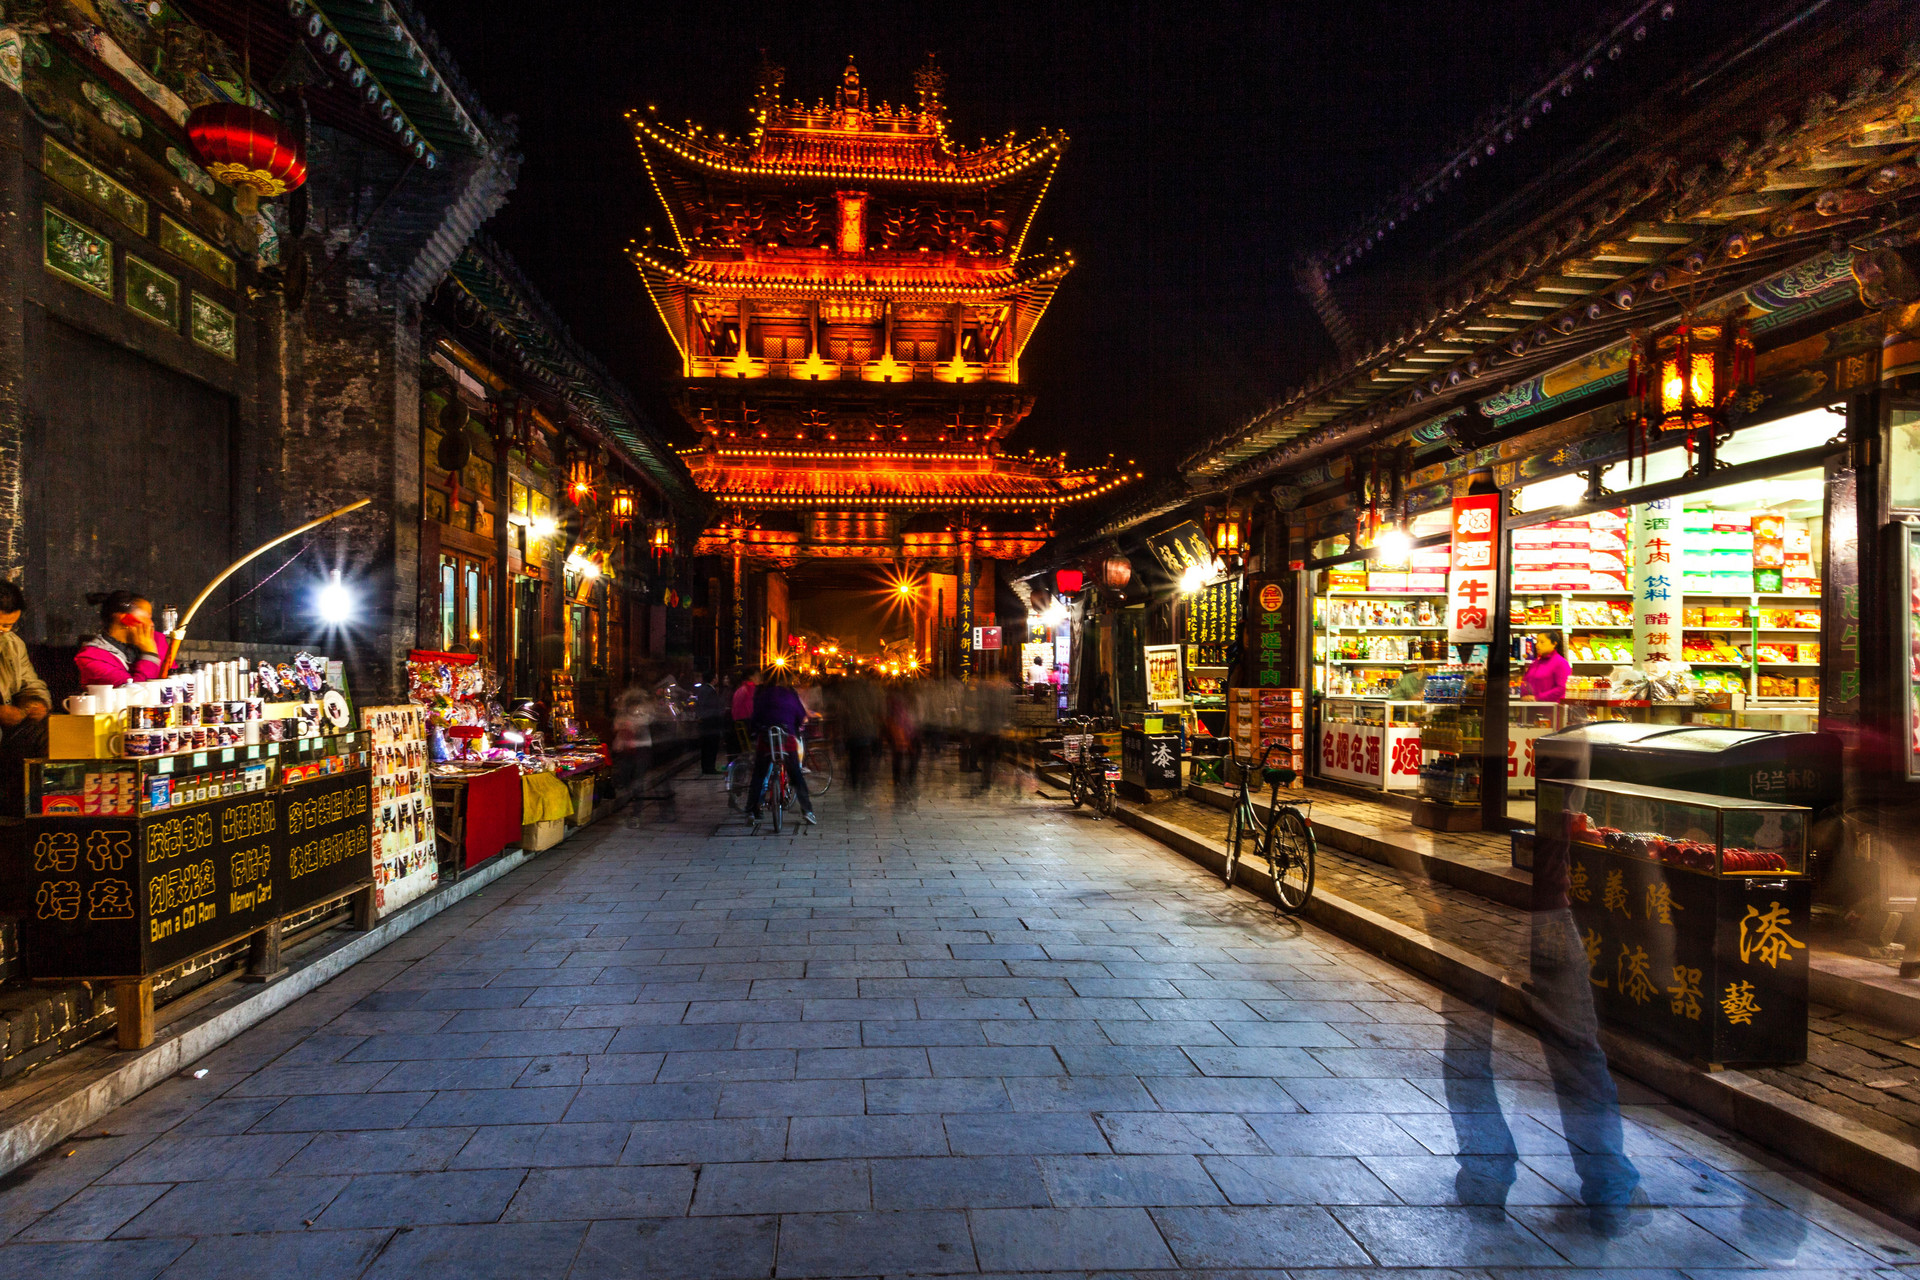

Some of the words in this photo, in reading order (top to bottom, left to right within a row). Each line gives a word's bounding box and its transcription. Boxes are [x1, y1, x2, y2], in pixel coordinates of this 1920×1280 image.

[1323, 730, 1380, 776] 名烟名酒
[34, 830, 132, 871] 烤杯
[230, 845, 271, 887] 存储卡
[36, 878, 135, 920] 烤盘
[150, 918, 172, 942] Burn
[175, 916, 181, 933] a
[183, 904, 196, 929] CD
[198, 902, 216, 926] Rom
[230, 889, 256, 914] Memory
[257, 880, 272, 904] Card
